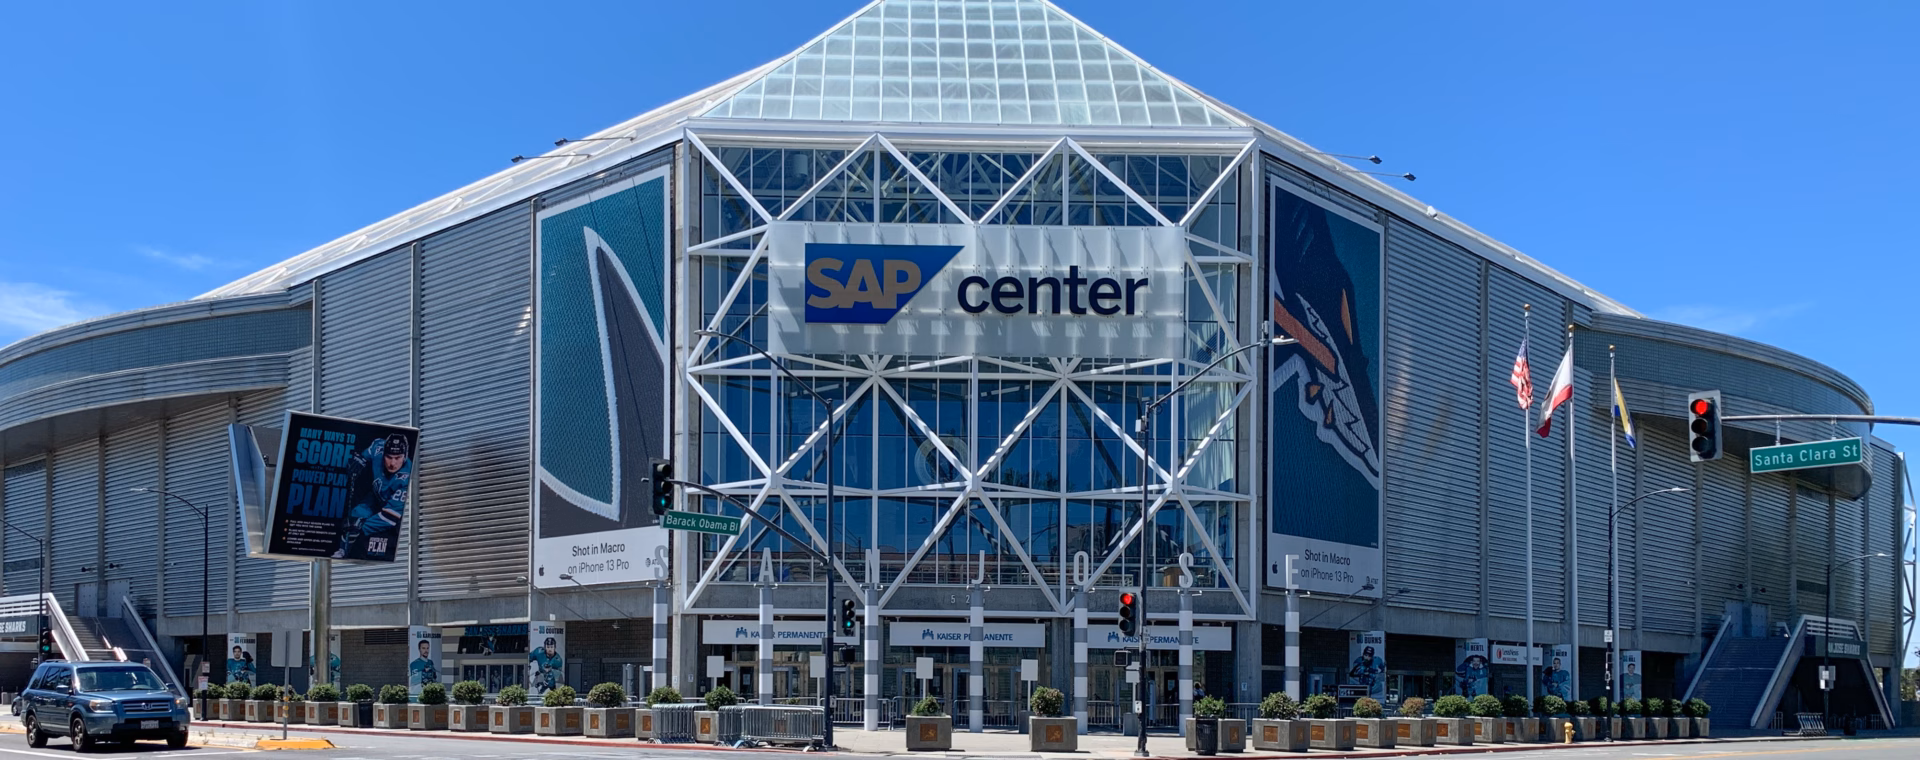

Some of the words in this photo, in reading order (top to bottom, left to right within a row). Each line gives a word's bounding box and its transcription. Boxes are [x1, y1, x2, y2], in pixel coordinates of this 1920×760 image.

[806, 257, 922, 310] SAP
[957, 264, 1149, 316] center
[301, 427, 323, 440] MANY
[323, 430, 345, 442] WAYS
[346, 433, 356, 444] TO
[1754, 451, 1794, 467] Santa
[1799, 448, 1836, 462] Clara
[1842, 444, 1858, 458] St
[291, 468, 326, 484] POWER
[326, 471, 349, 487] PLAY
[286, 482, 347, 519] PLAN
[666, 514, 696, 528] Barack
[699, 518, 728, 531] Obama
[367, 541, 388, 553] PLAN
[572, 545, 590, 557] Shot
[591, 544, 599, 555] in
[600, 542, 626, 554] Macro
[1304, 548, 1321, 561] Shot
[1321, 551, 1329, 563] in
[1329, 552, 1351, 566] Macro
[567, 565, 578, 575] on
[578, 561, 605, 574] iPhone
[606, 559, 615, 571] 13
[616, 558, 630, 571] Pro
[1300, 568, 1310, 578] on
[1310, 567, 1334, 581] iPhone
[1334, 570, 1343, 582] 13
[1343, 571, 1354, 583] Pro
[5, 620, 26, 632] SHARKS
[497, 624, 528, 635] SHARKS
[777, 631, 826, 639] PERMANENTE
[936, 632, 962, 640] KAISER
[1364, 636, 1382, 644] BURNS
[1470, 644, 1485, 652] HERTL
